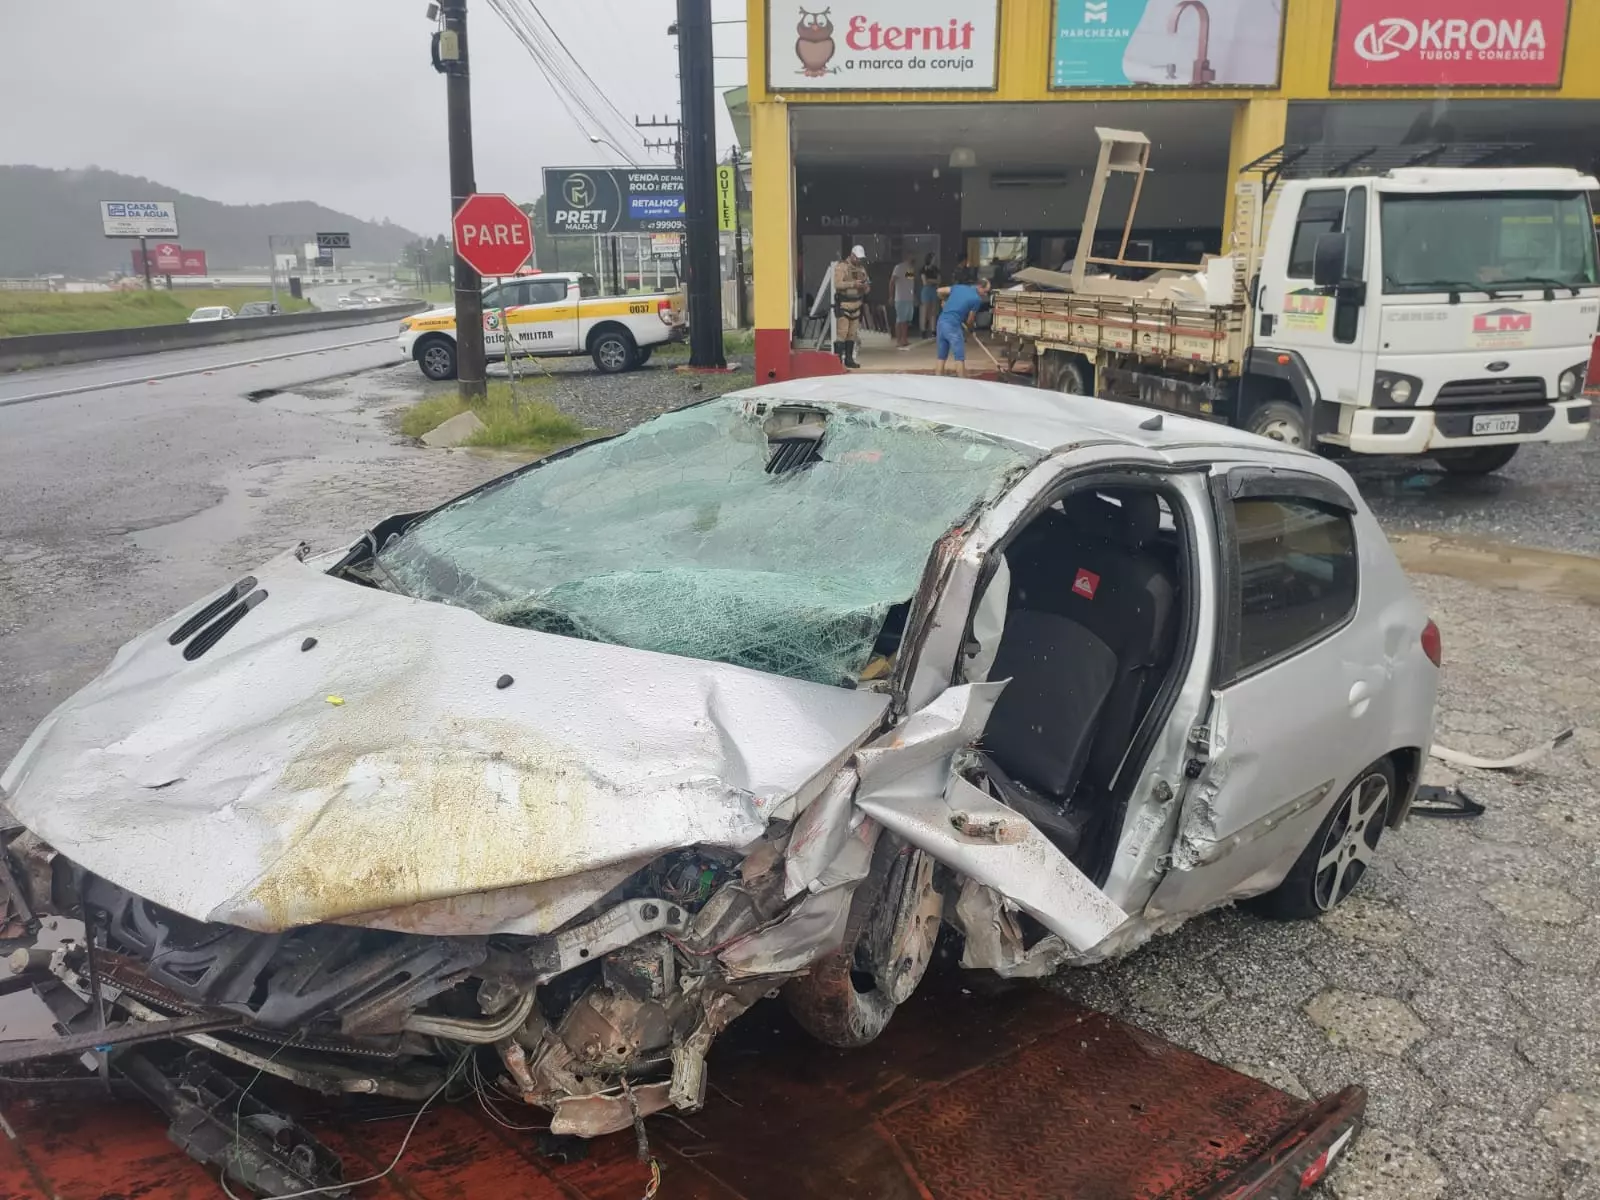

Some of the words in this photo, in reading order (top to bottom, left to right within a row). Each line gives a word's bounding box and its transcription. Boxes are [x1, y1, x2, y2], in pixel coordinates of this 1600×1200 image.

[846, 15, 975, 50] Eternit
[1061, 28, 1129, 37] MARCHEZAN
[1420, 18, 1546, 50] KRONA
[1420, 50, 1460, 60] TUBOS
[1465, 50, 1473, 60] E
[845, 59, 854, 69] a
[859, 58, 903, 69] marca
[908, 56, 926, 69] da
[930, 56, 974, 72] coruja
[628, 174, 659, 182] VENDA
[629, 183, 655, 191] ROLO
[632, 199, 679, 208] RETALHOS
[720, 170, 729, 228] OUTLET
[555, 210, 607, 224] PRETI
[462, 223, 524, 246] PARE
[629, 304, 649, 314] 0037
[1473, 313, 1532, 332] LM
[518, 330, 554, 341] MILITAR
